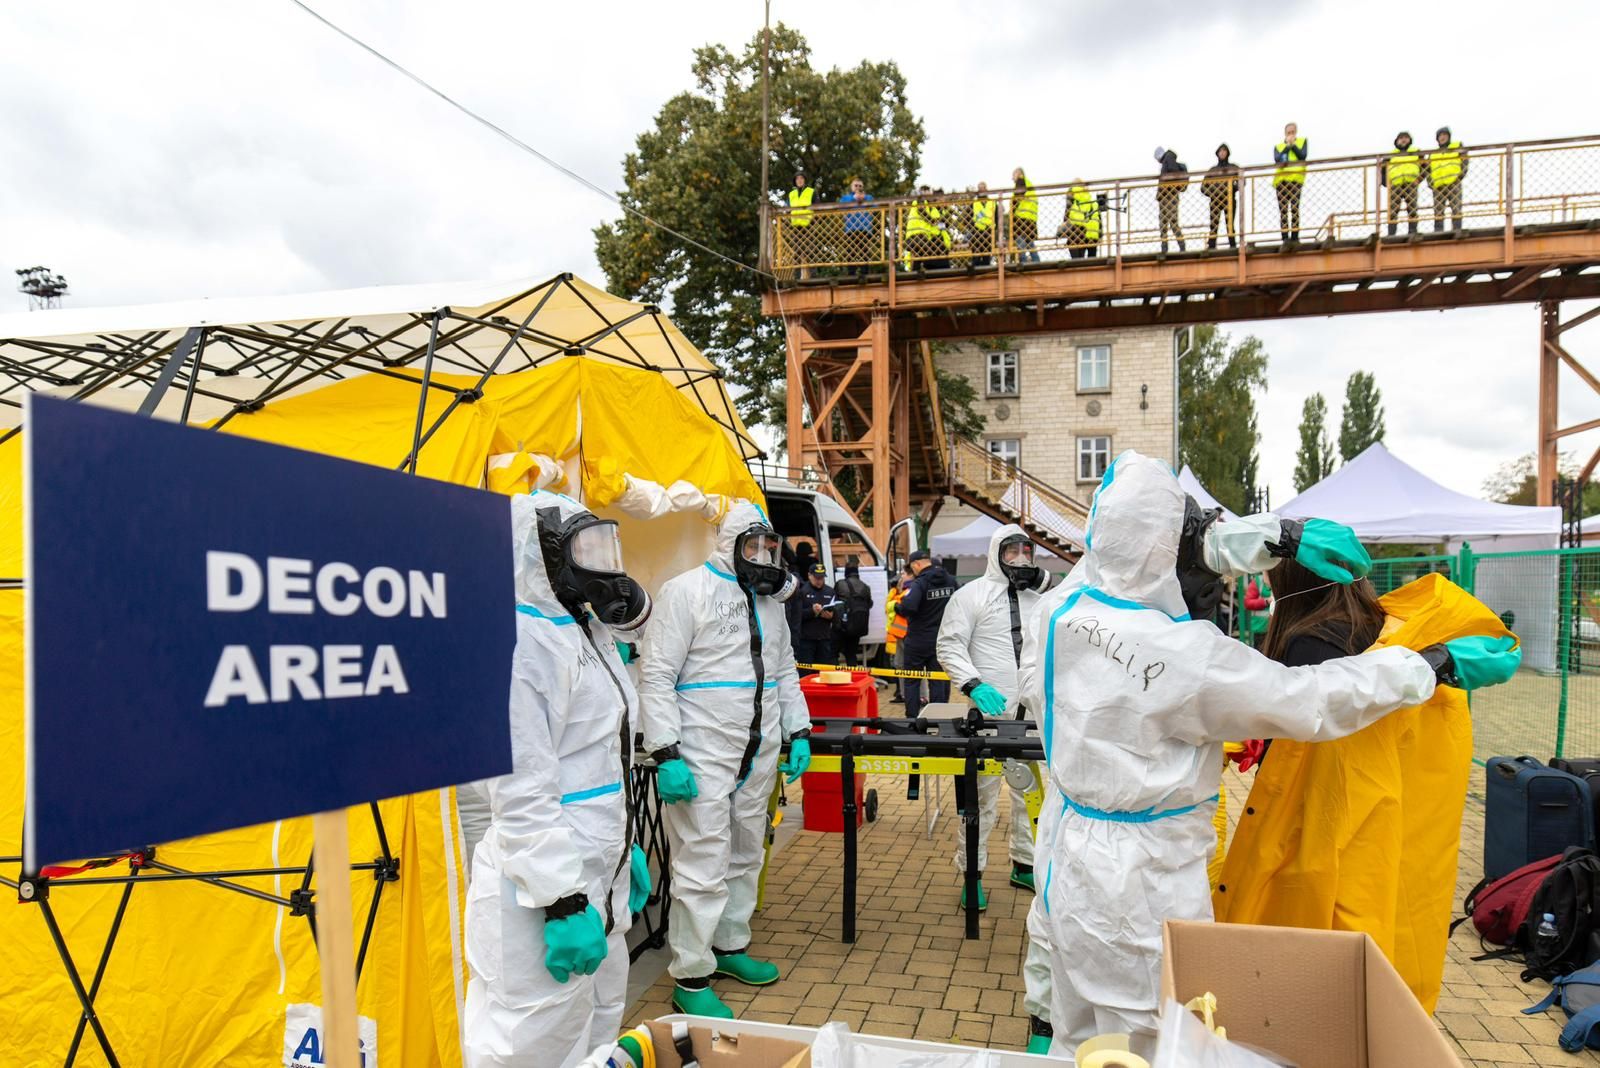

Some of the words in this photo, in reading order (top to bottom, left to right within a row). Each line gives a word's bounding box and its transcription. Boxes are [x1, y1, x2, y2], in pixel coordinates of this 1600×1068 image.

[206, 551, 447, 618] DECON
[204, 645, 409, 707] AREA
[894, 670, 932, 678] CAUTION
